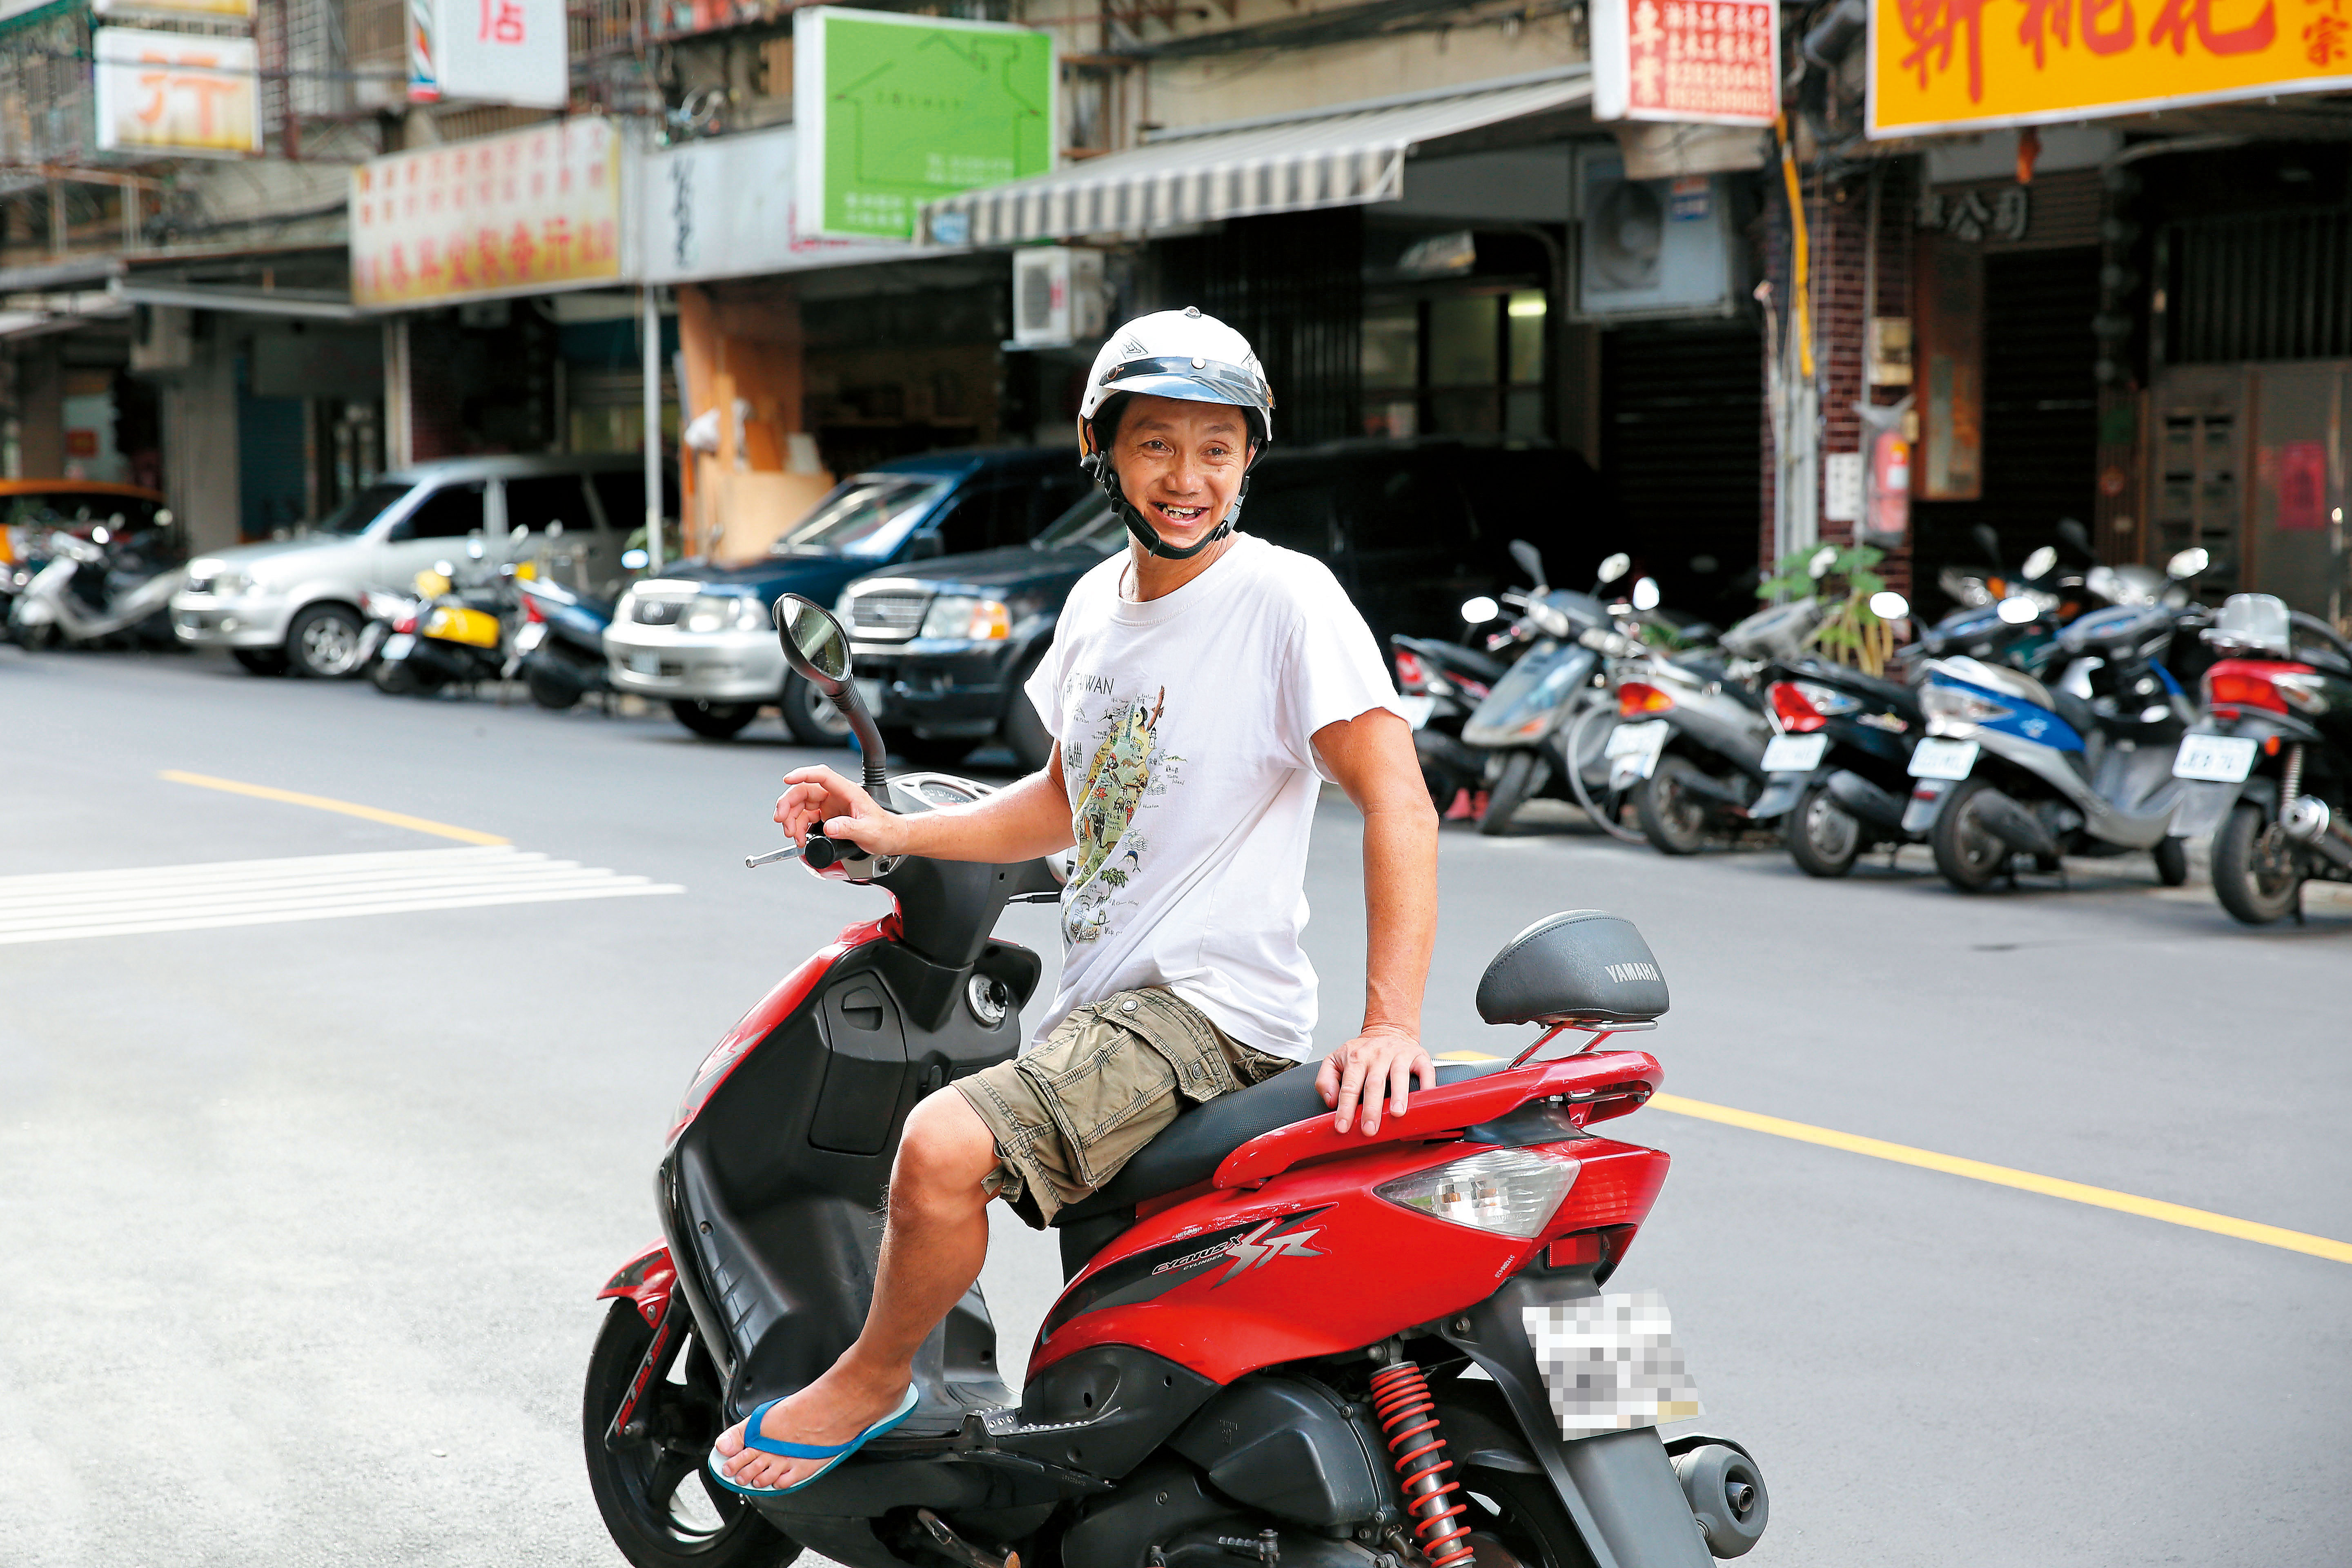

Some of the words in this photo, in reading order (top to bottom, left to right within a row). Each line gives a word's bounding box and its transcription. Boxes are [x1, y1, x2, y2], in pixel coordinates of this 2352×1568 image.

[1076, 673, 1114, 695] TAIWAN
[1605, 962, 1660, 983] YAMAHA
[1152, 1241, 1229, 1276] CYGNUS
[1183, 1253, 1225, 1271] CYLINDER
